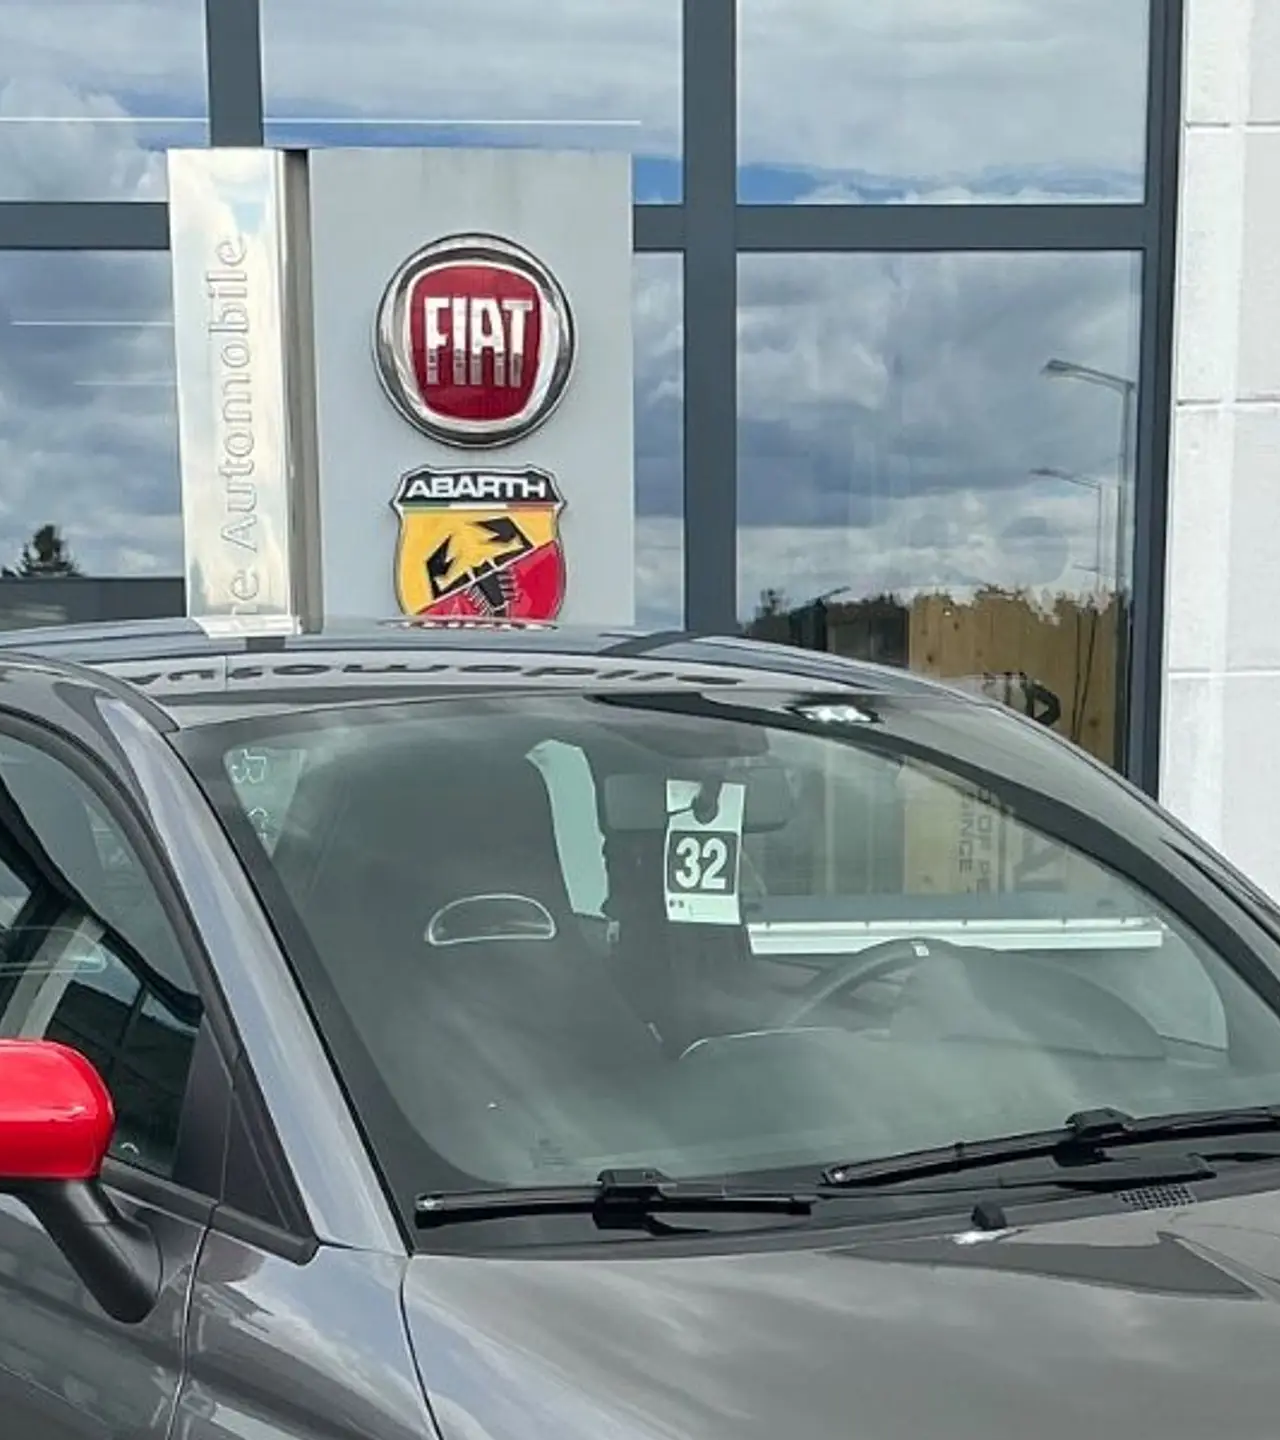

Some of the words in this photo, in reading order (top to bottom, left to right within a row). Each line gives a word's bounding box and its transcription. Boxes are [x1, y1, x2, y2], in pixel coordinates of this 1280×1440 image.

[423, 296, 534, 386] FIAT
[206, 233, 260, 553] Automobile
[404, 475, 547, 501] ABARTH
[675, 836, 727, 889] 32
